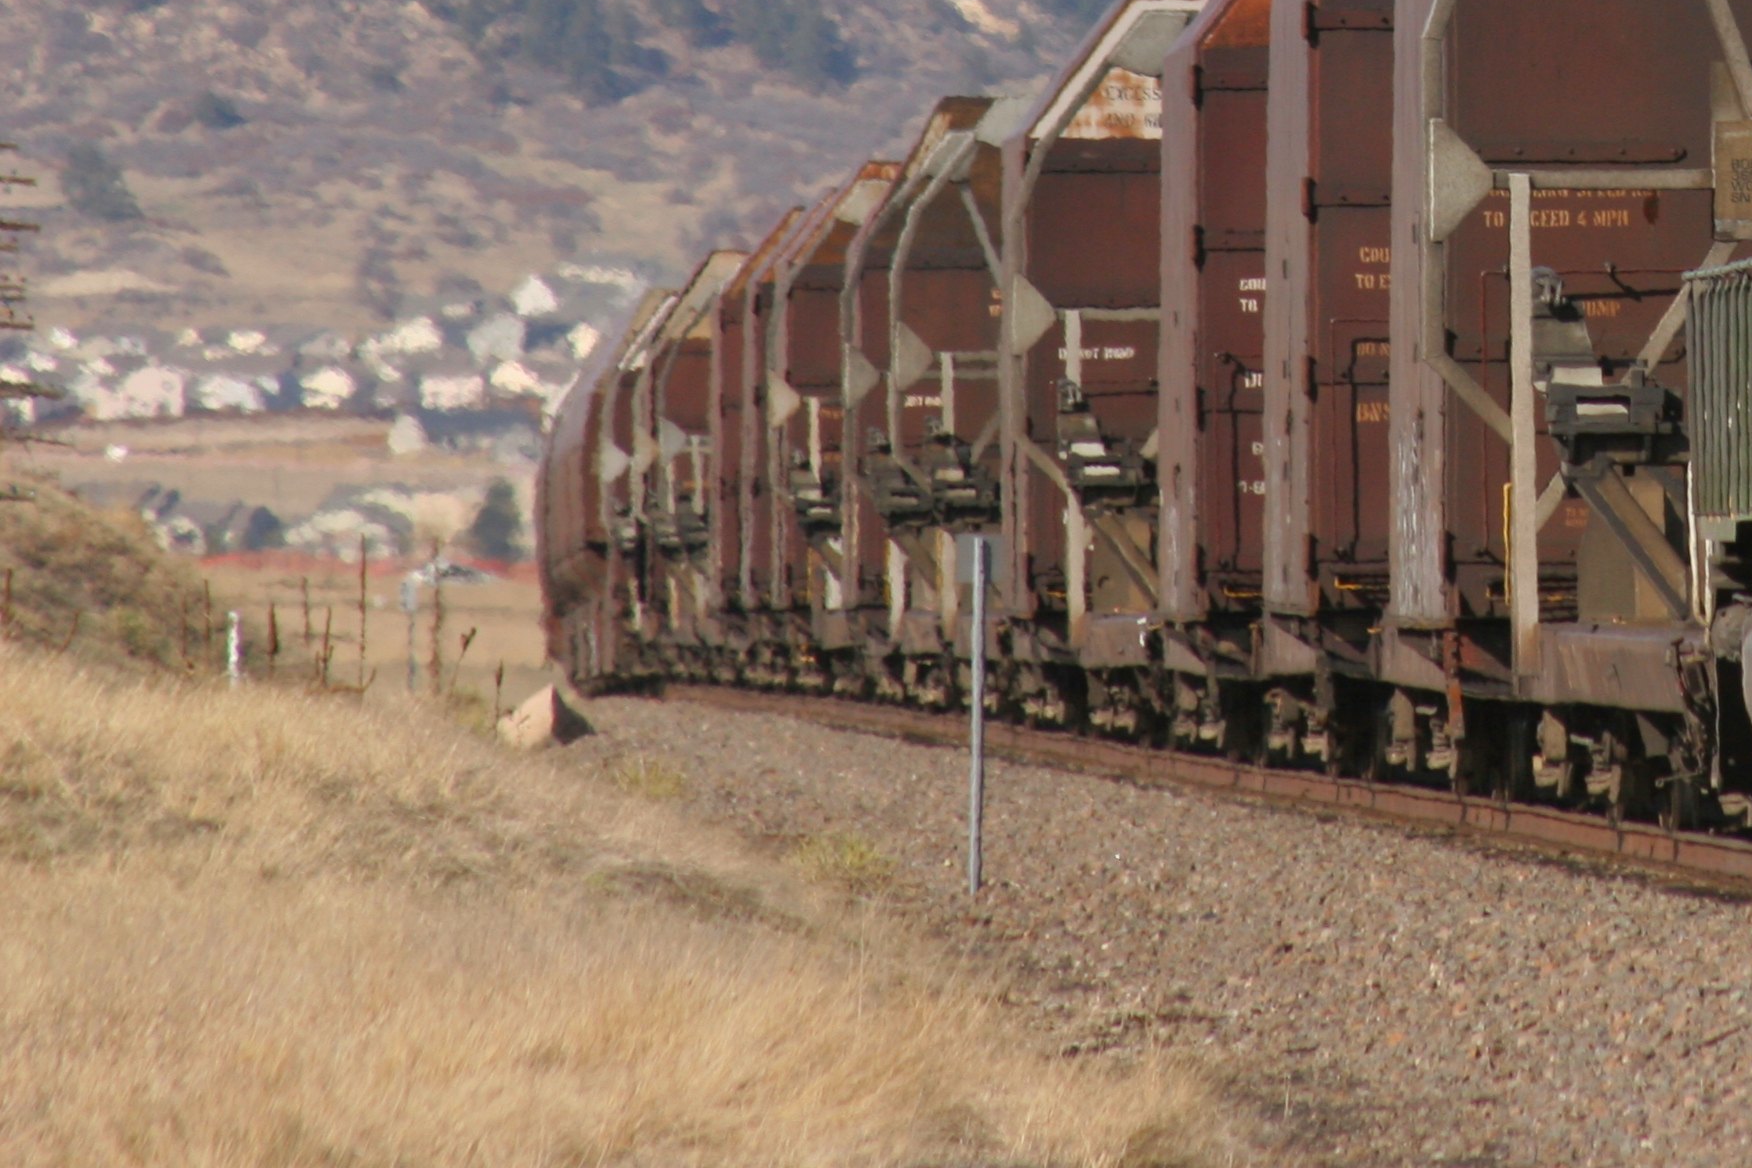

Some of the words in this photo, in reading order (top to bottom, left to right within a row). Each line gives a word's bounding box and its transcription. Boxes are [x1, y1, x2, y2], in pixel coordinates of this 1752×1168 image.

[1483, 211, 1505, 228] TO
[1593, 209, 1630, 228] MPH
[1354, 273, 1375, 290] TO
[1239, 298, 1258, 313] TO
